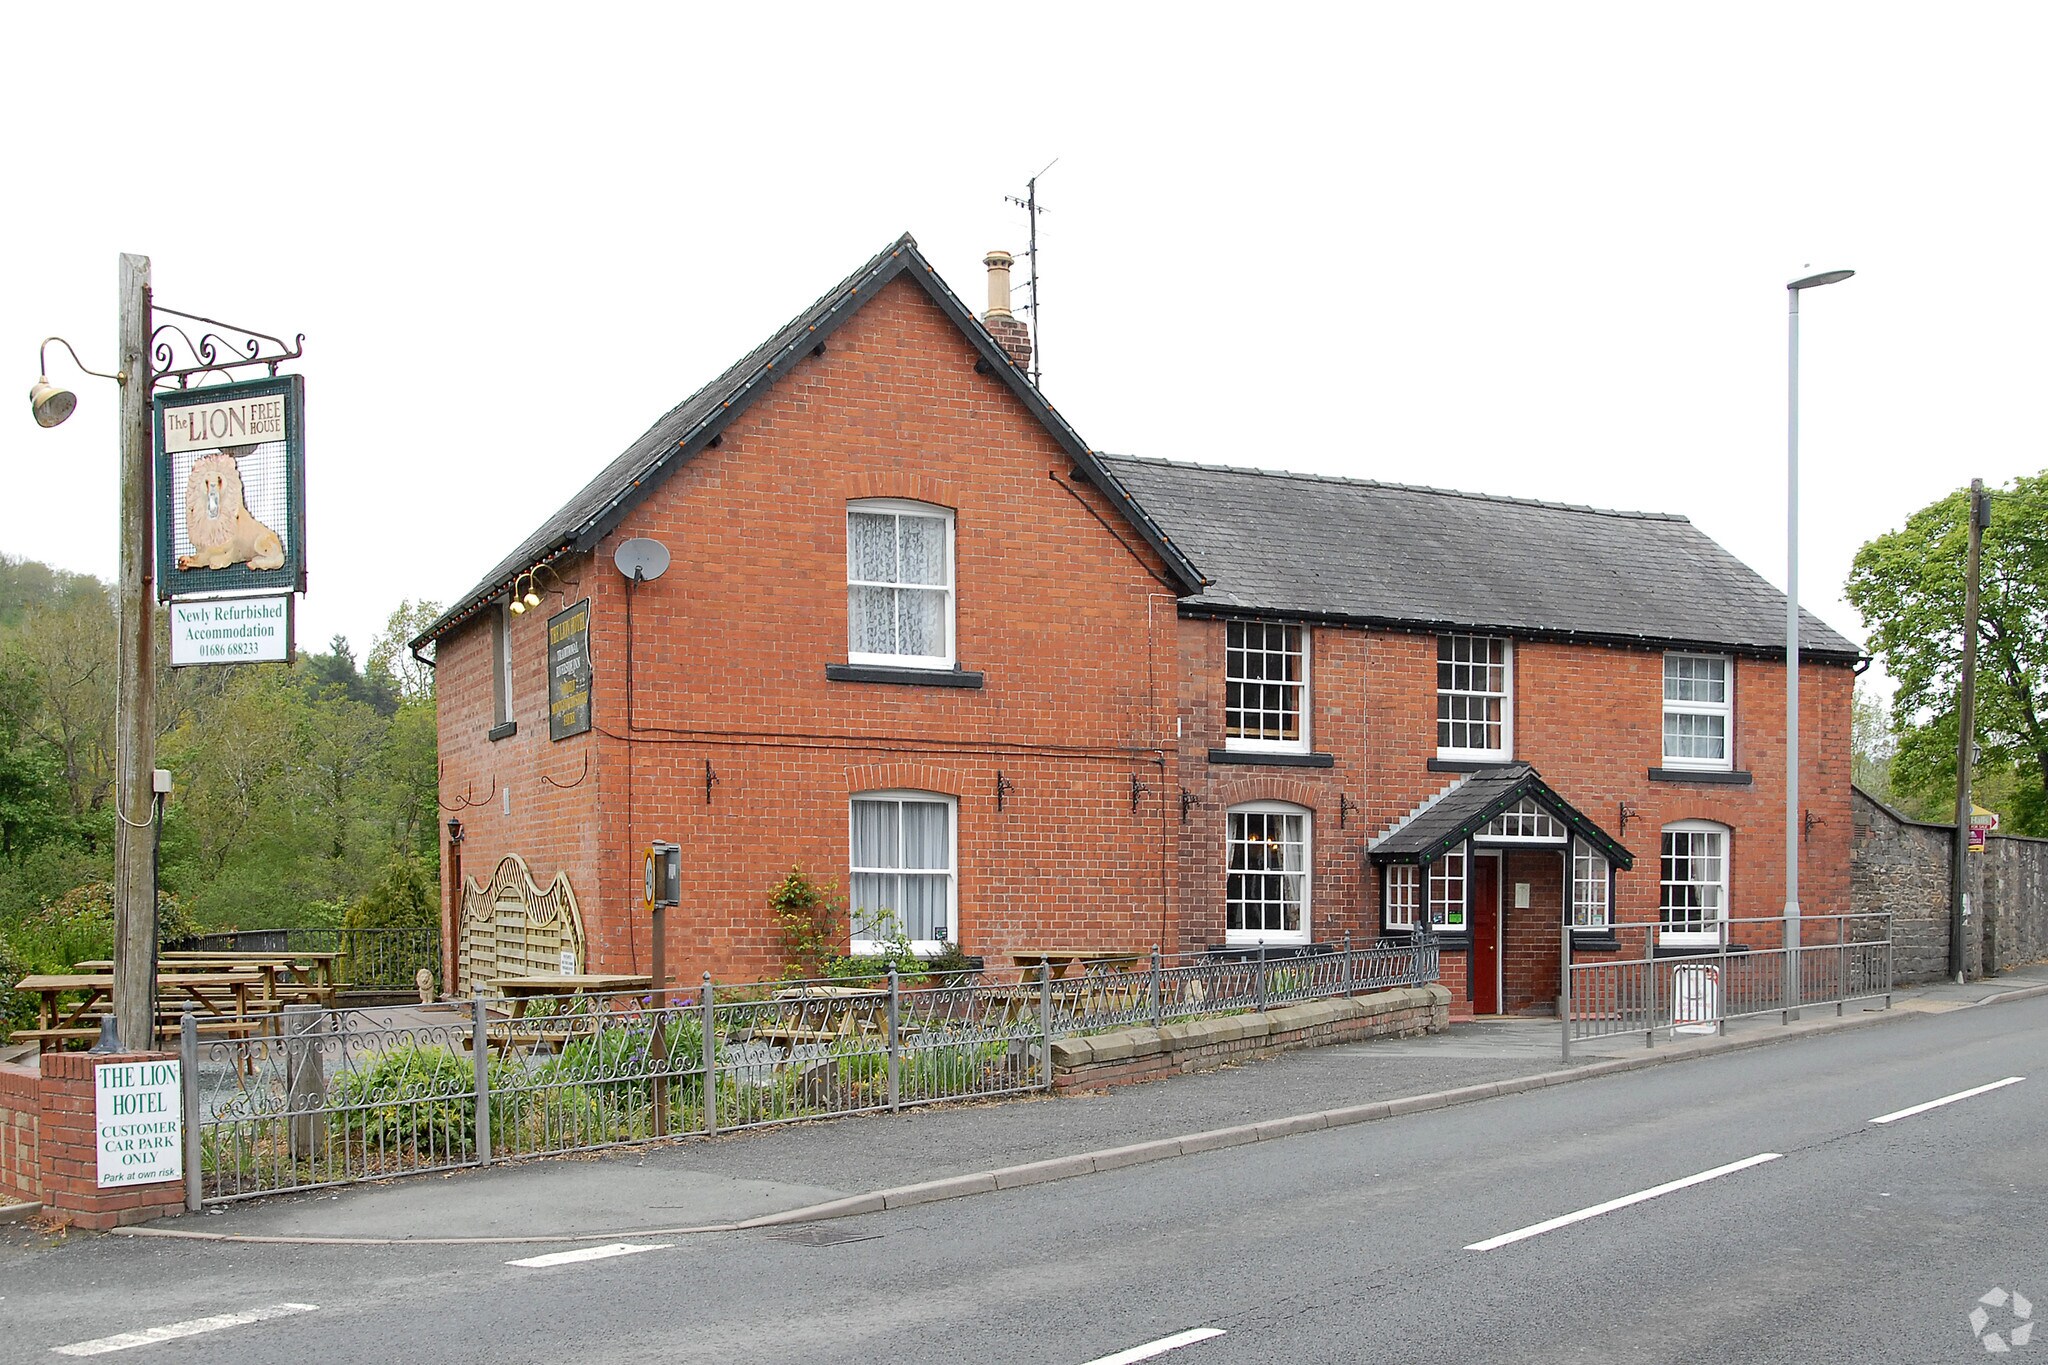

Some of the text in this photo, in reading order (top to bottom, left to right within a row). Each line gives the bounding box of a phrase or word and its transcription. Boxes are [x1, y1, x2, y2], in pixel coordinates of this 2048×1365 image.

[250, 401, 280, 420] FREE
[168, 406, 246, 441] The LION
[250, 419, 280, 434] HOUSE
[178, 604, 282, 625] Newly Refurbished
[186, 623, 274, 640] Accommodation
[200, 642, 258, 656] 01686 688233
[100, 1064, 176, 1088] THE LION
[113, 1092, 167, 1116] HOTEL
[102, 1122, 176, 1138] CUSTOMER
[105, 1136, 174, 1152] CAR PARK
[122, 1151, 159, 1165] ONLY
[103, 1173, 124, 1182] Park
[127, 1172, 136, 1180] at
[159, 1168, 175, 1177] risk
